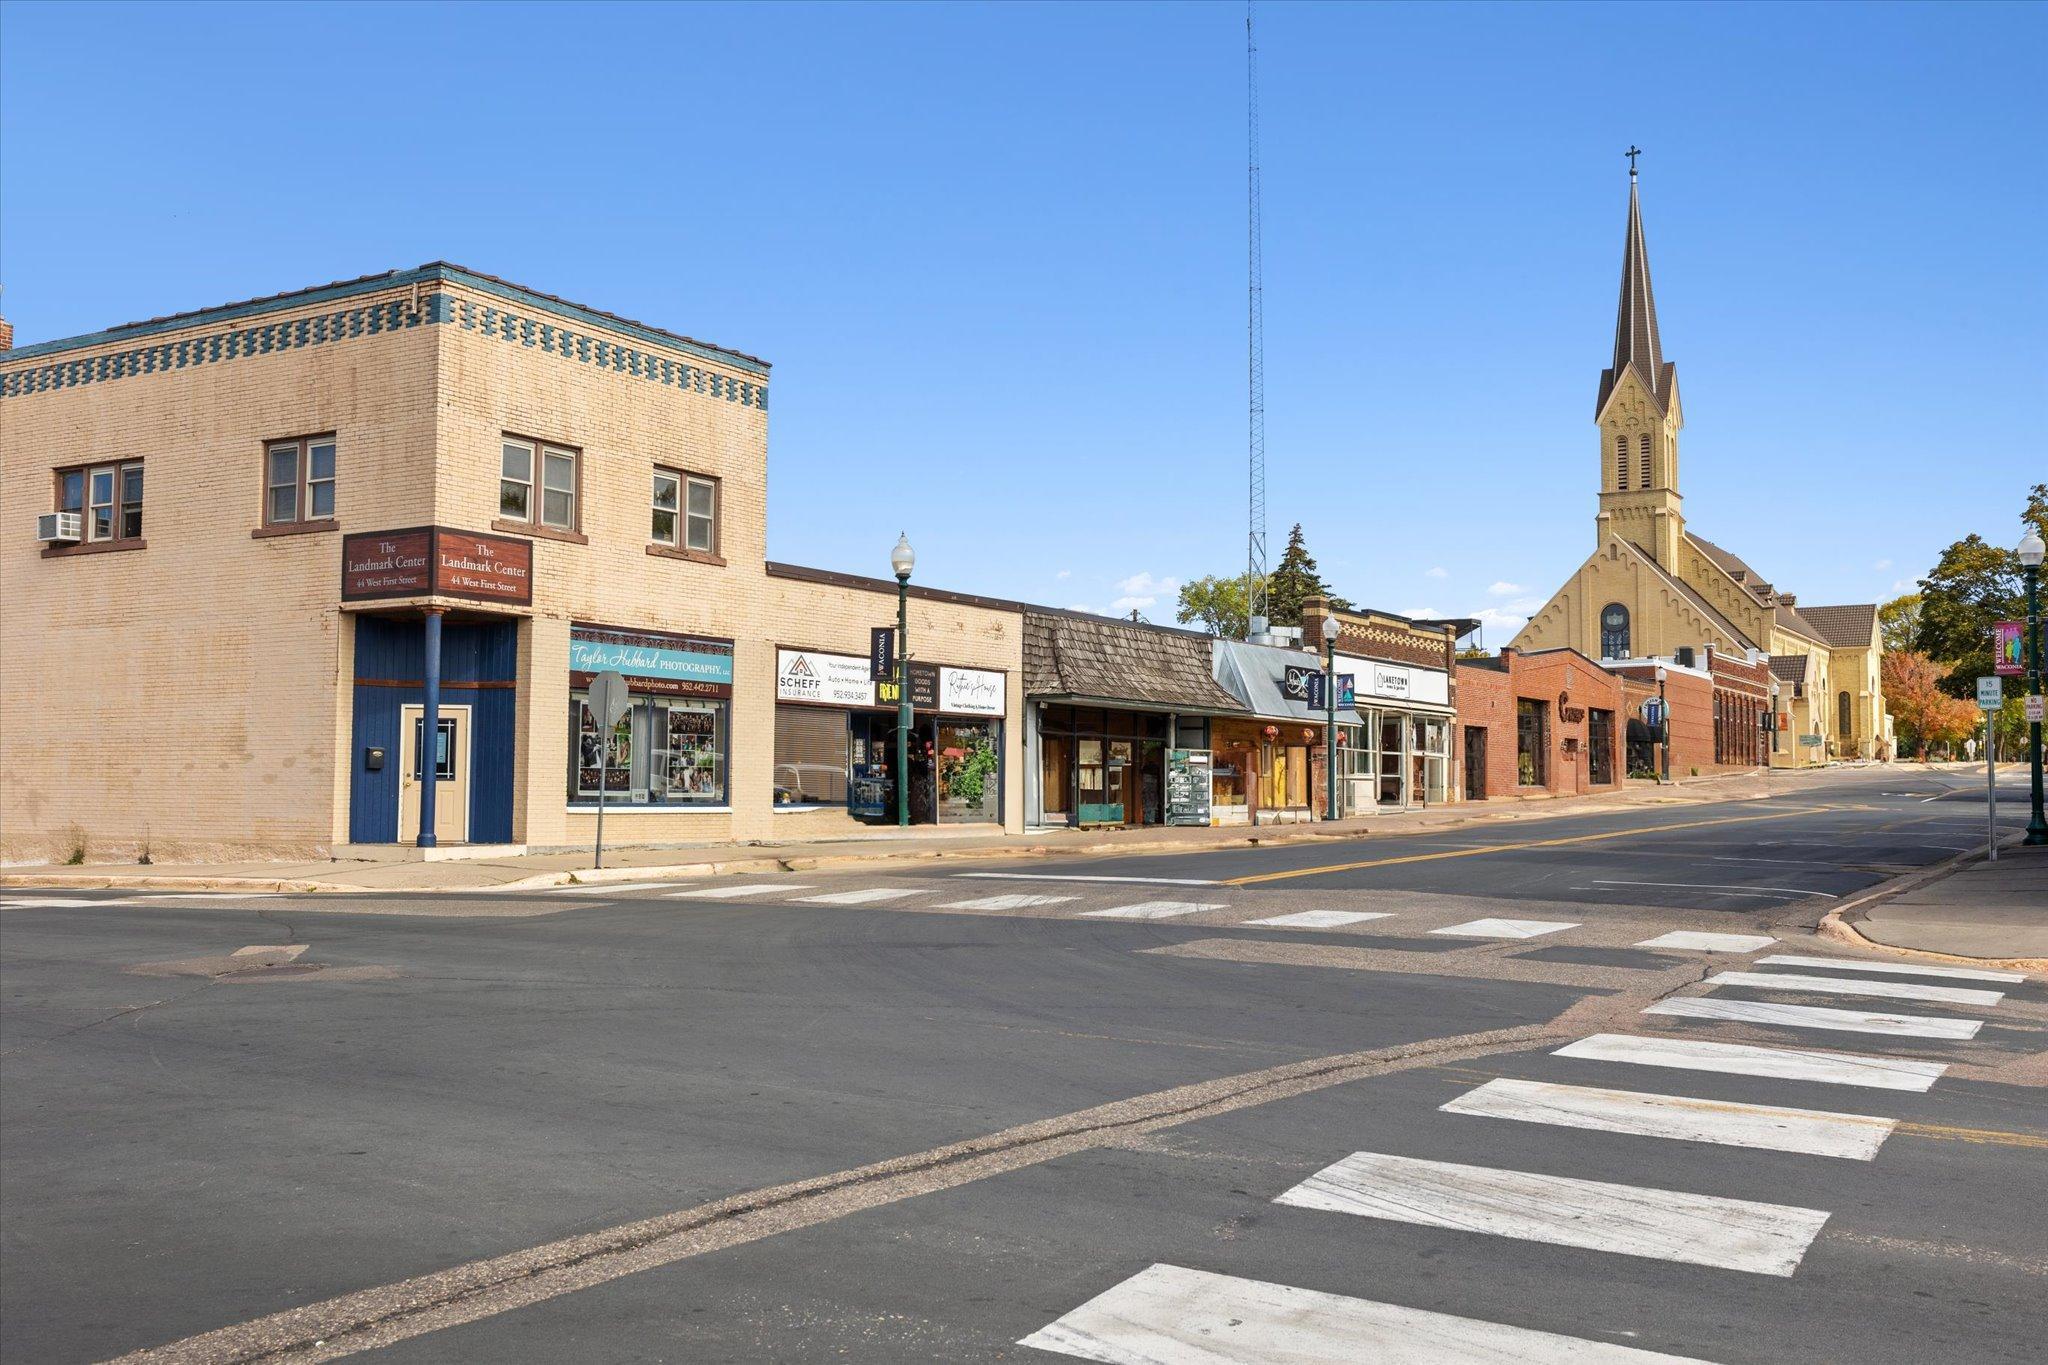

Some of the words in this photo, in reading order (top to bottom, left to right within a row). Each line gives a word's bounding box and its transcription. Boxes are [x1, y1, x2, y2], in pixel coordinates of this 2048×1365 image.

[379, 542, 396, 554] The
[476, 544, 494, 556] The
[349, 557, 394, 572] Landmark
[396, 556, 426, 568] Center
[442, 554, 492, 572] Landmark
[494, 562, 526, 577] Center
[356, 578, 365, 588] 44
[366, 578, 381, 587] West
[383, 576, 397, 586] First
[399, 575, 417, 584] Street
[451, 575, 460, 584] 44
[462, 577, 479, 587] West
[480, 578, 496, 590] First
[497, 582, 516, 592] Street
[610, 648, 659, 668] Hubbard
[780, 677, 820, 689] SCHEFF
[780, 688, 820, 698] INSURANCE
